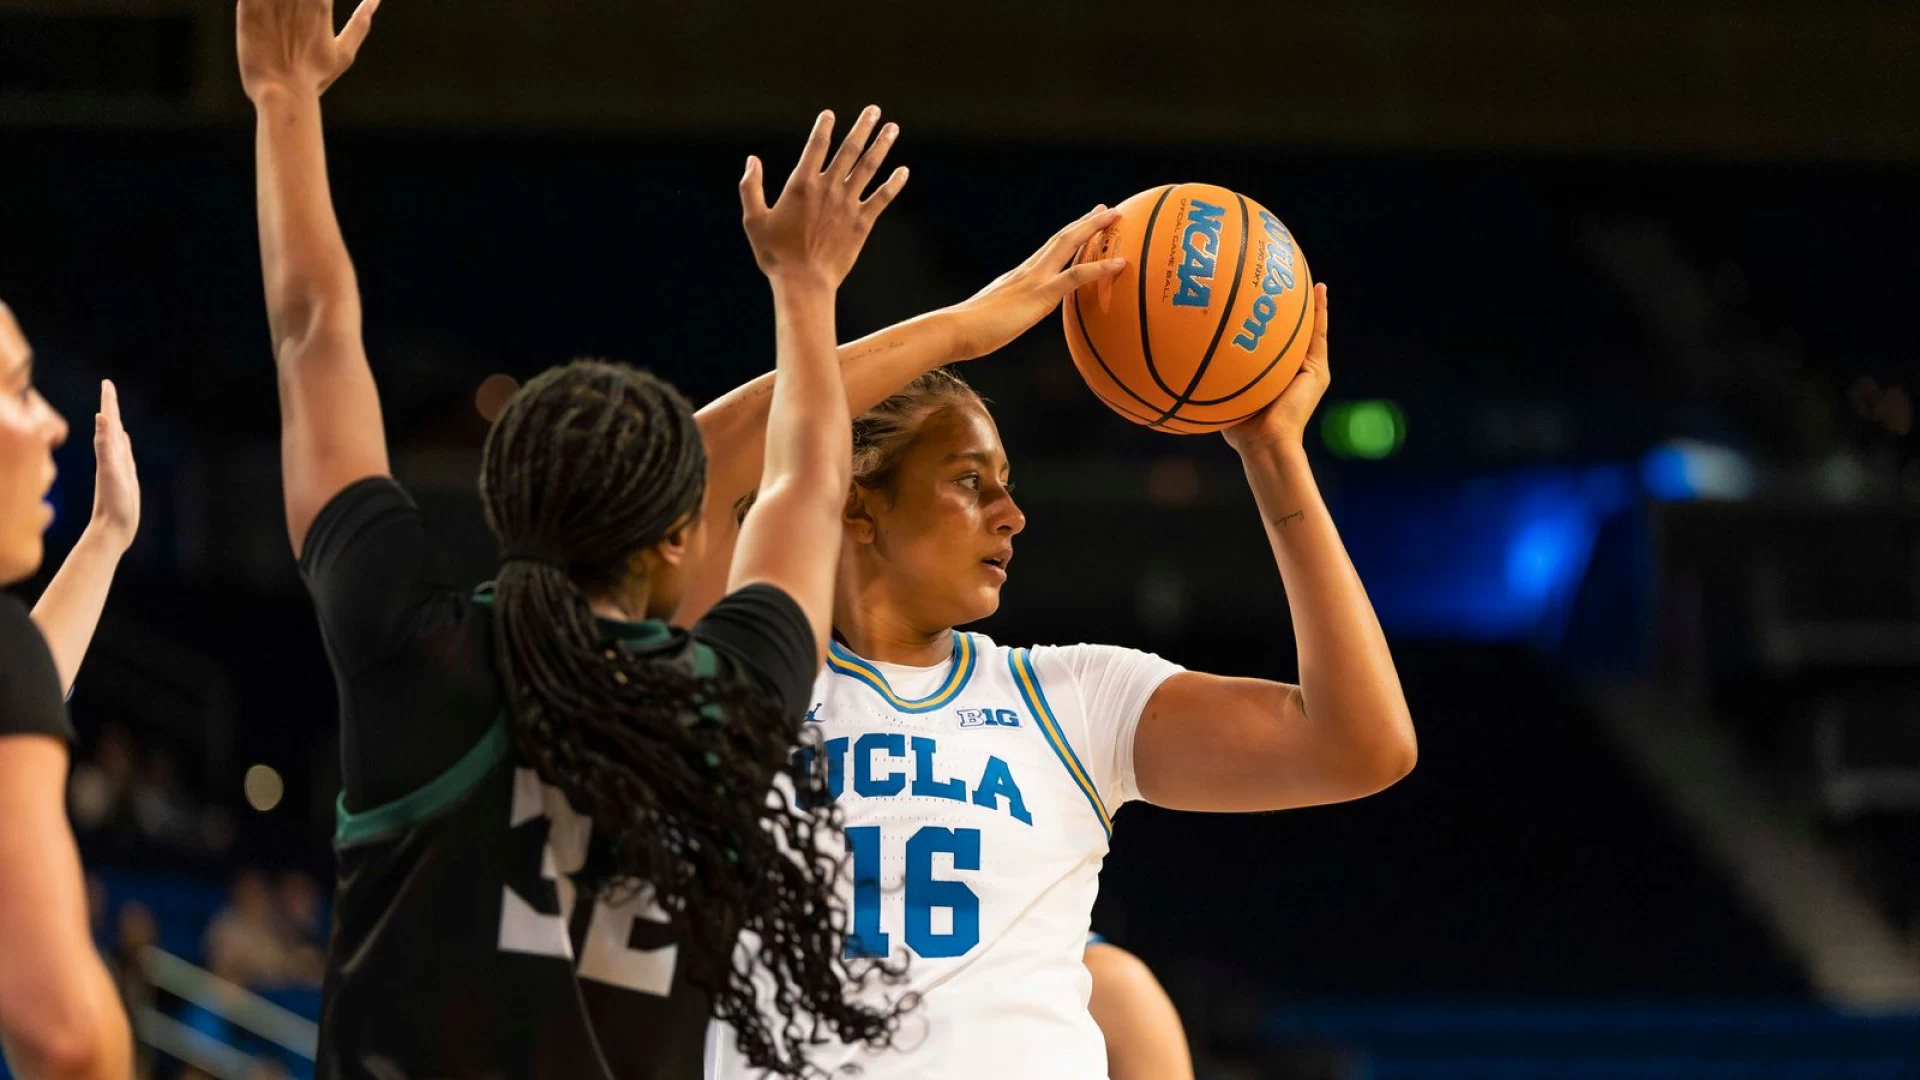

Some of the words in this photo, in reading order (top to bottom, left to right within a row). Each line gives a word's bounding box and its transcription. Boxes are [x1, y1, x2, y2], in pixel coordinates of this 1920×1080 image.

[1162, 270, 1173, 303] BALL
[1168, 235, 1179, 267] GAME
[1172, 199, 1226, 307] NCAA
[1232, 210, 1295, 351] Wilson
[844, 826, 981, 959] 16
